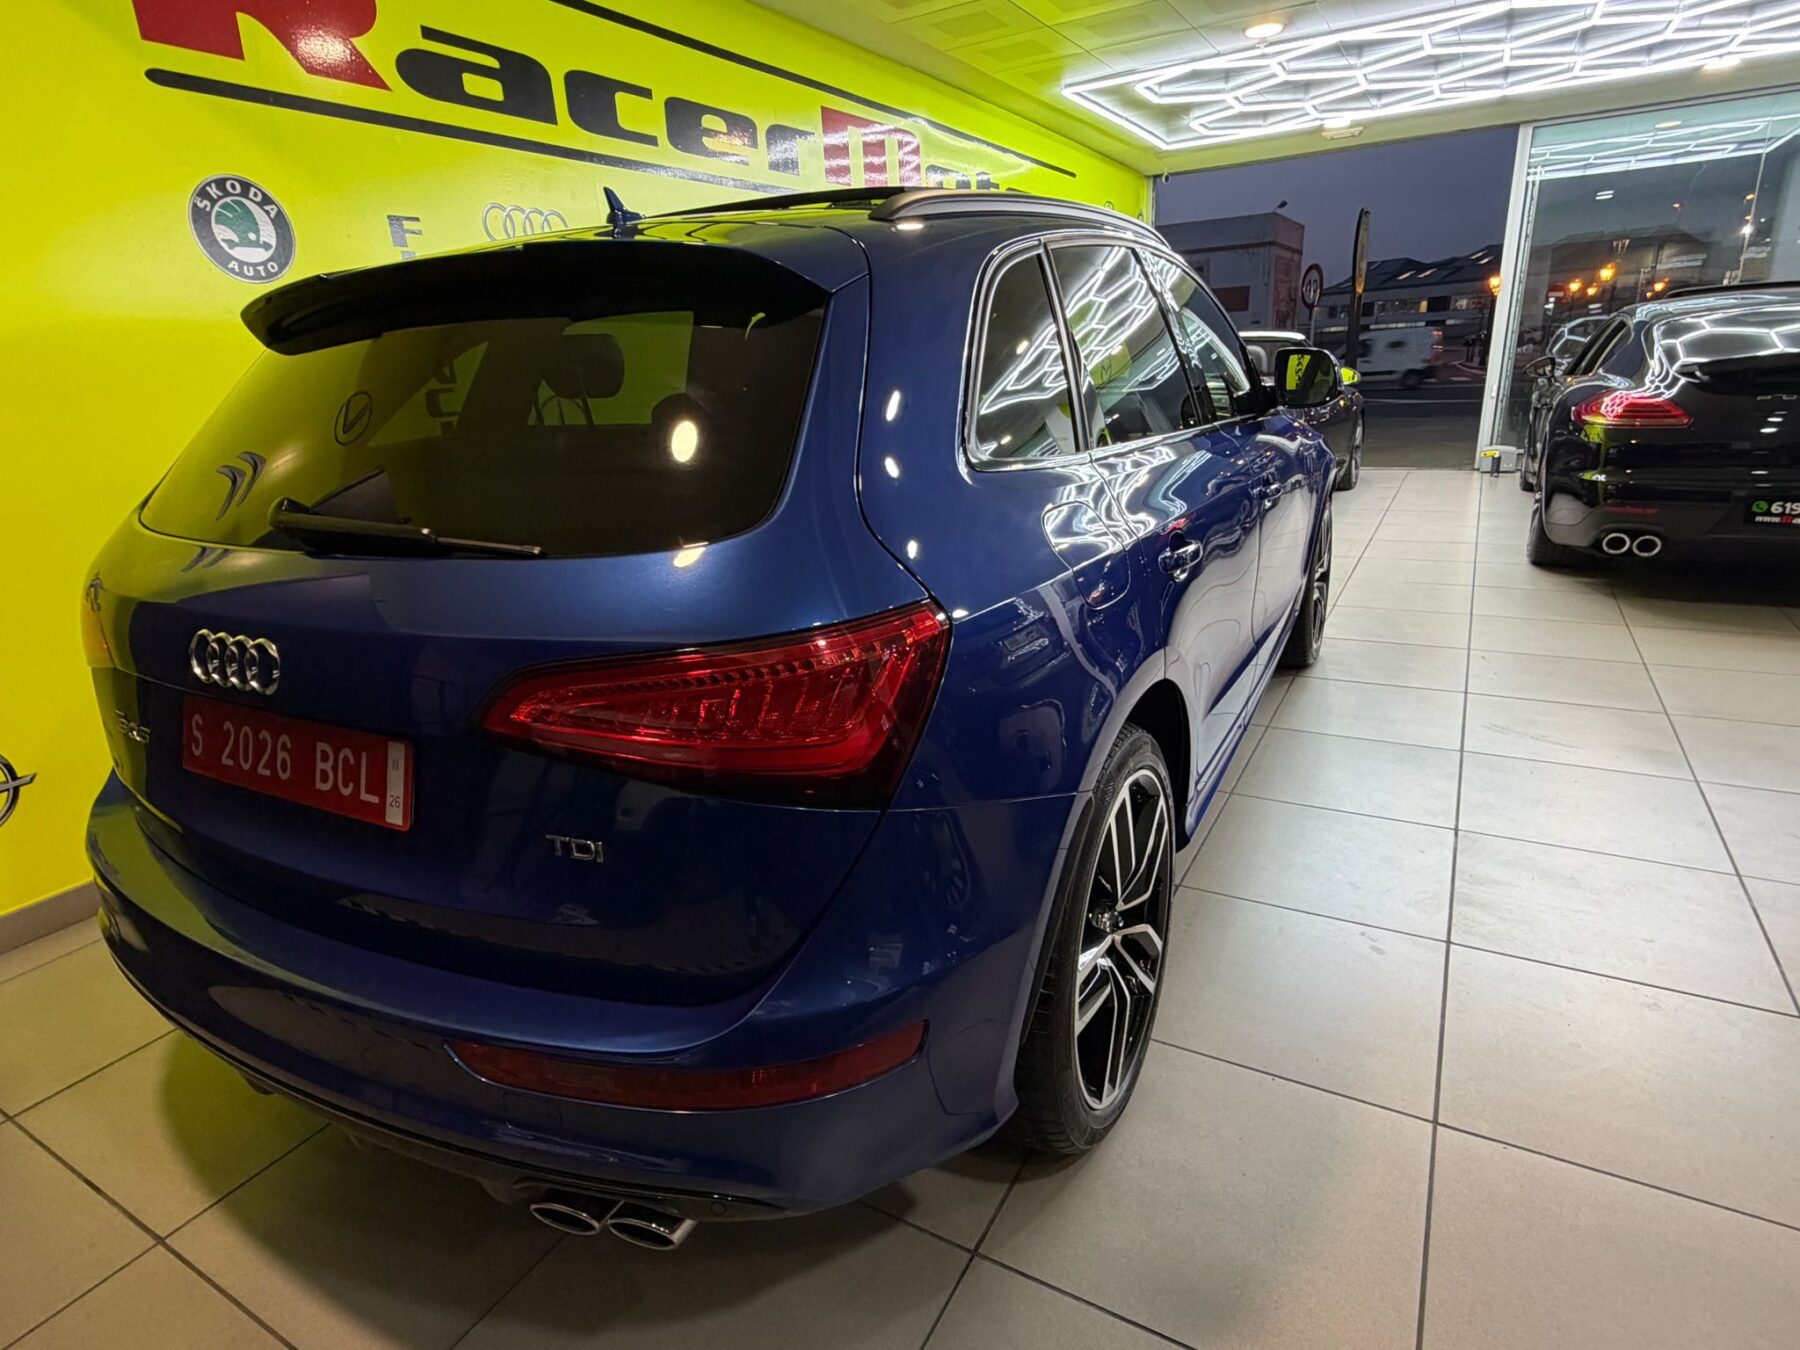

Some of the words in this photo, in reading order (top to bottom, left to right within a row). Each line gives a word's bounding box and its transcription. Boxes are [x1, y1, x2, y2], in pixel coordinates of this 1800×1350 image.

[228, 261, 279, 277] AUTO
[191, 714, 204, 757] S
[221, 720, 293, 781] 2026
[315, 741, 380, 804] BCL
[388, 794, 402, 809] 26
[545, 834, 604, 863] TDI
